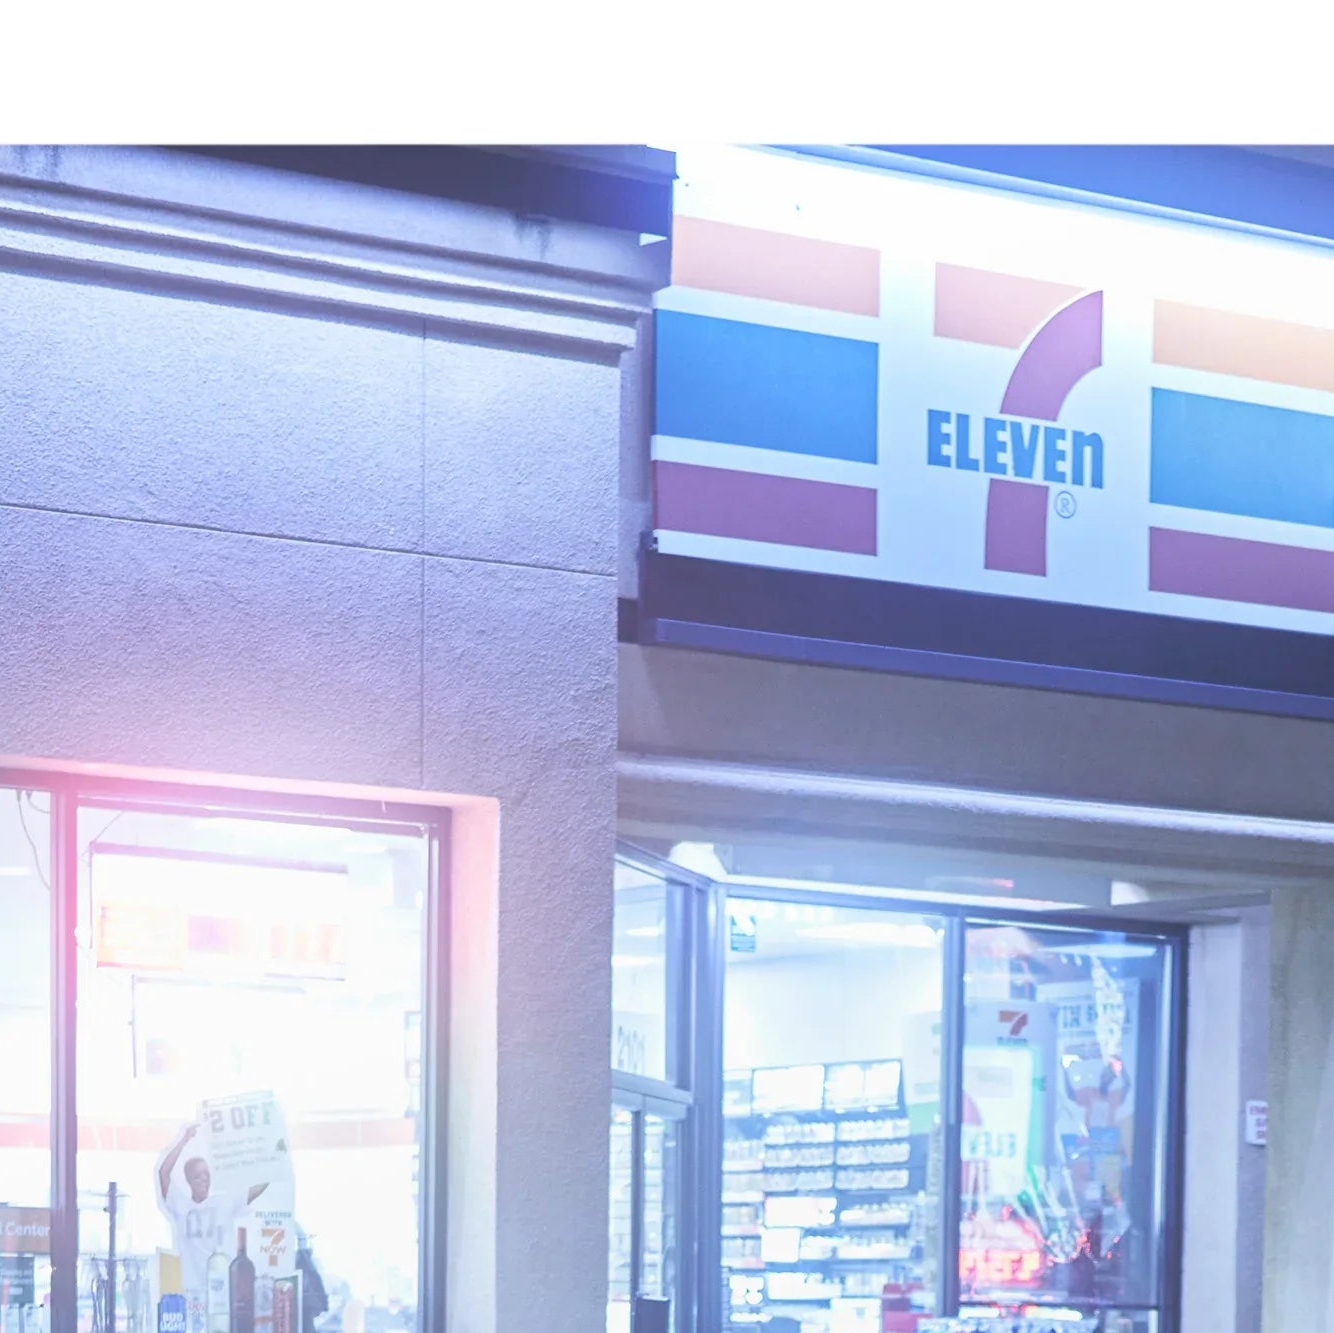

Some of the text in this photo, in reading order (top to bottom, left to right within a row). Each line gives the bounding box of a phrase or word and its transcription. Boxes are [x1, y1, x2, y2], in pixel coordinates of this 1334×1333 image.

[934, 261, 1104, 578] 7
[5, 1221, 51, 1237] Center
[162, 1312, 184, 1322] BUD
